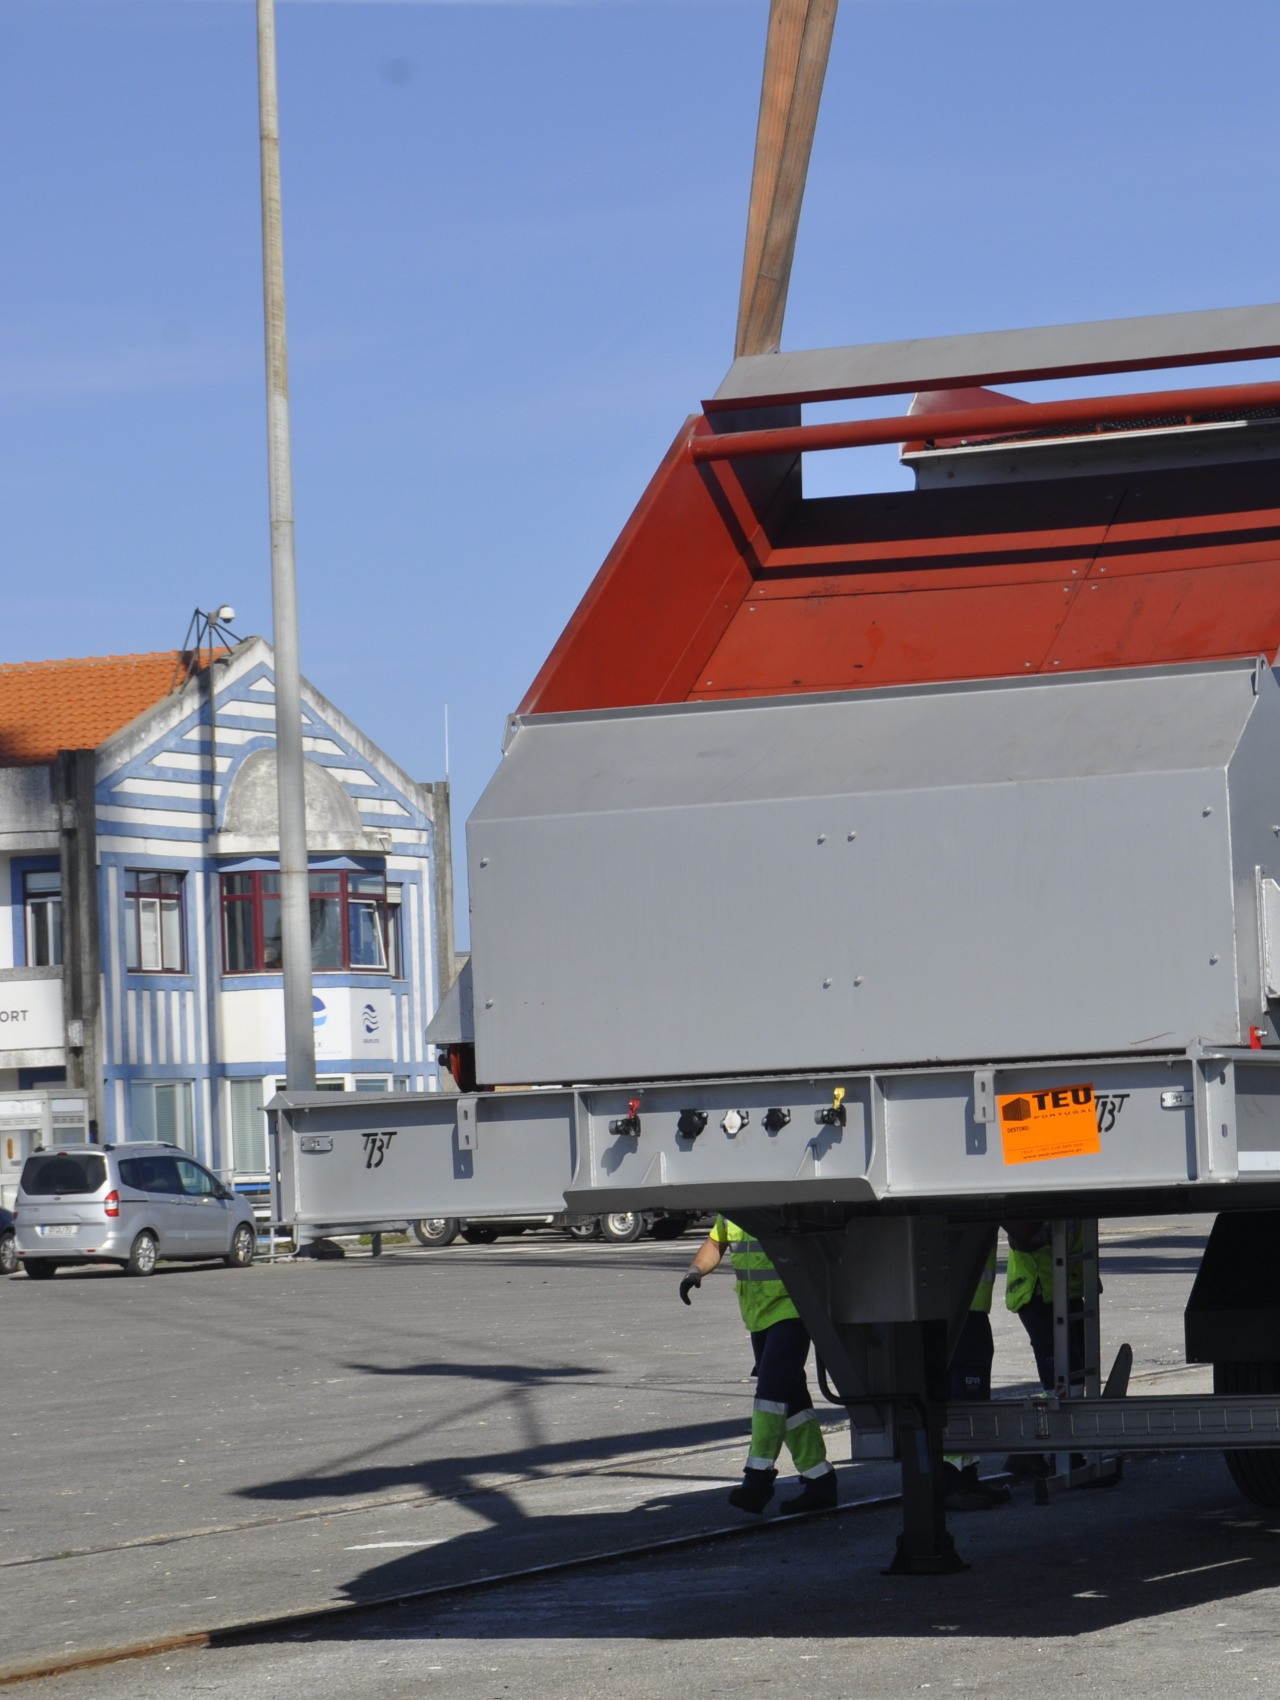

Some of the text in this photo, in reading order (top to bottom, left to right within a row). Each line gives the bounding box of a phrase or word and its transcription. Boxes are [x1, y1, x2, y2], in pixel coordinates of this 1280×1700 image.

[1032, 1087, 1092, 1110] TEU
[1034, 1109, 1093, 1119] PORTUGAL
[361, 1131, 397, 1169] TBT
